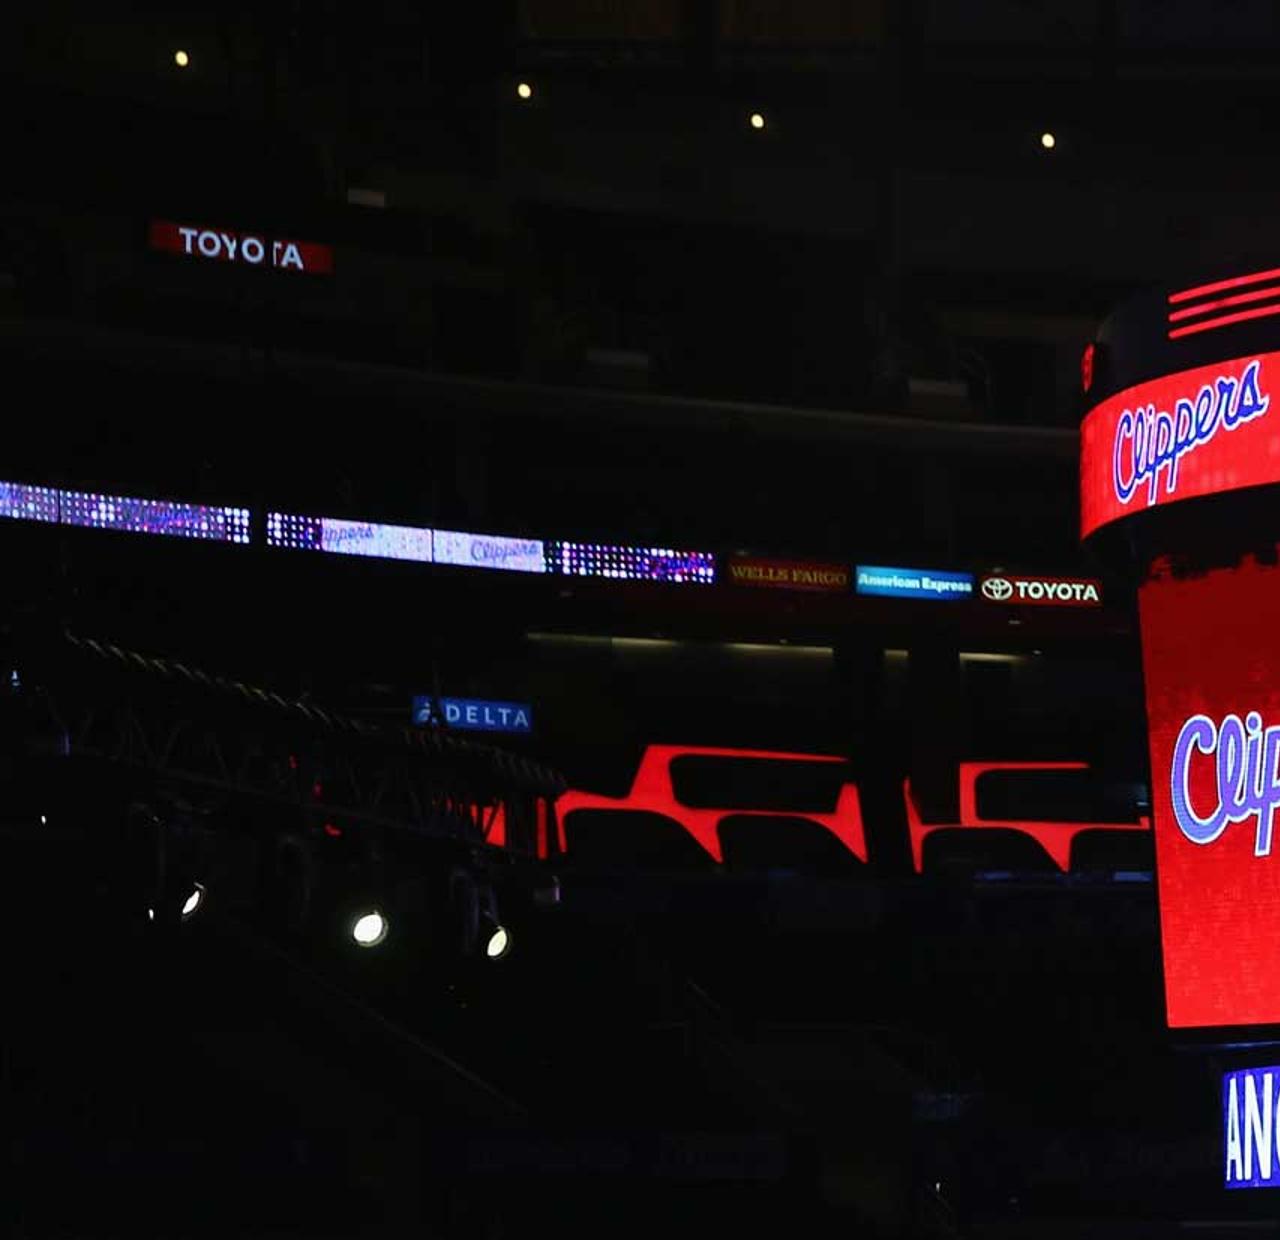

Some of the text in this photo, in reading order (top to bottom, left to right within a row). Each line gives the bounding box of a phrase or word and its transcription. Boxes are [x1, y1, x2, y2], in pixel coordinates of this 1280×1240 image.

[1113, 360, 1270, 506] Clippers
[731, 565, 789, 580] WELLS
[792, 569, 846, 584] FARGO
[858, 573, 973, 593] American Express
[1016, 581, 1099, 601] TOYOTA
[445, 704, 529, 728] DELTA
